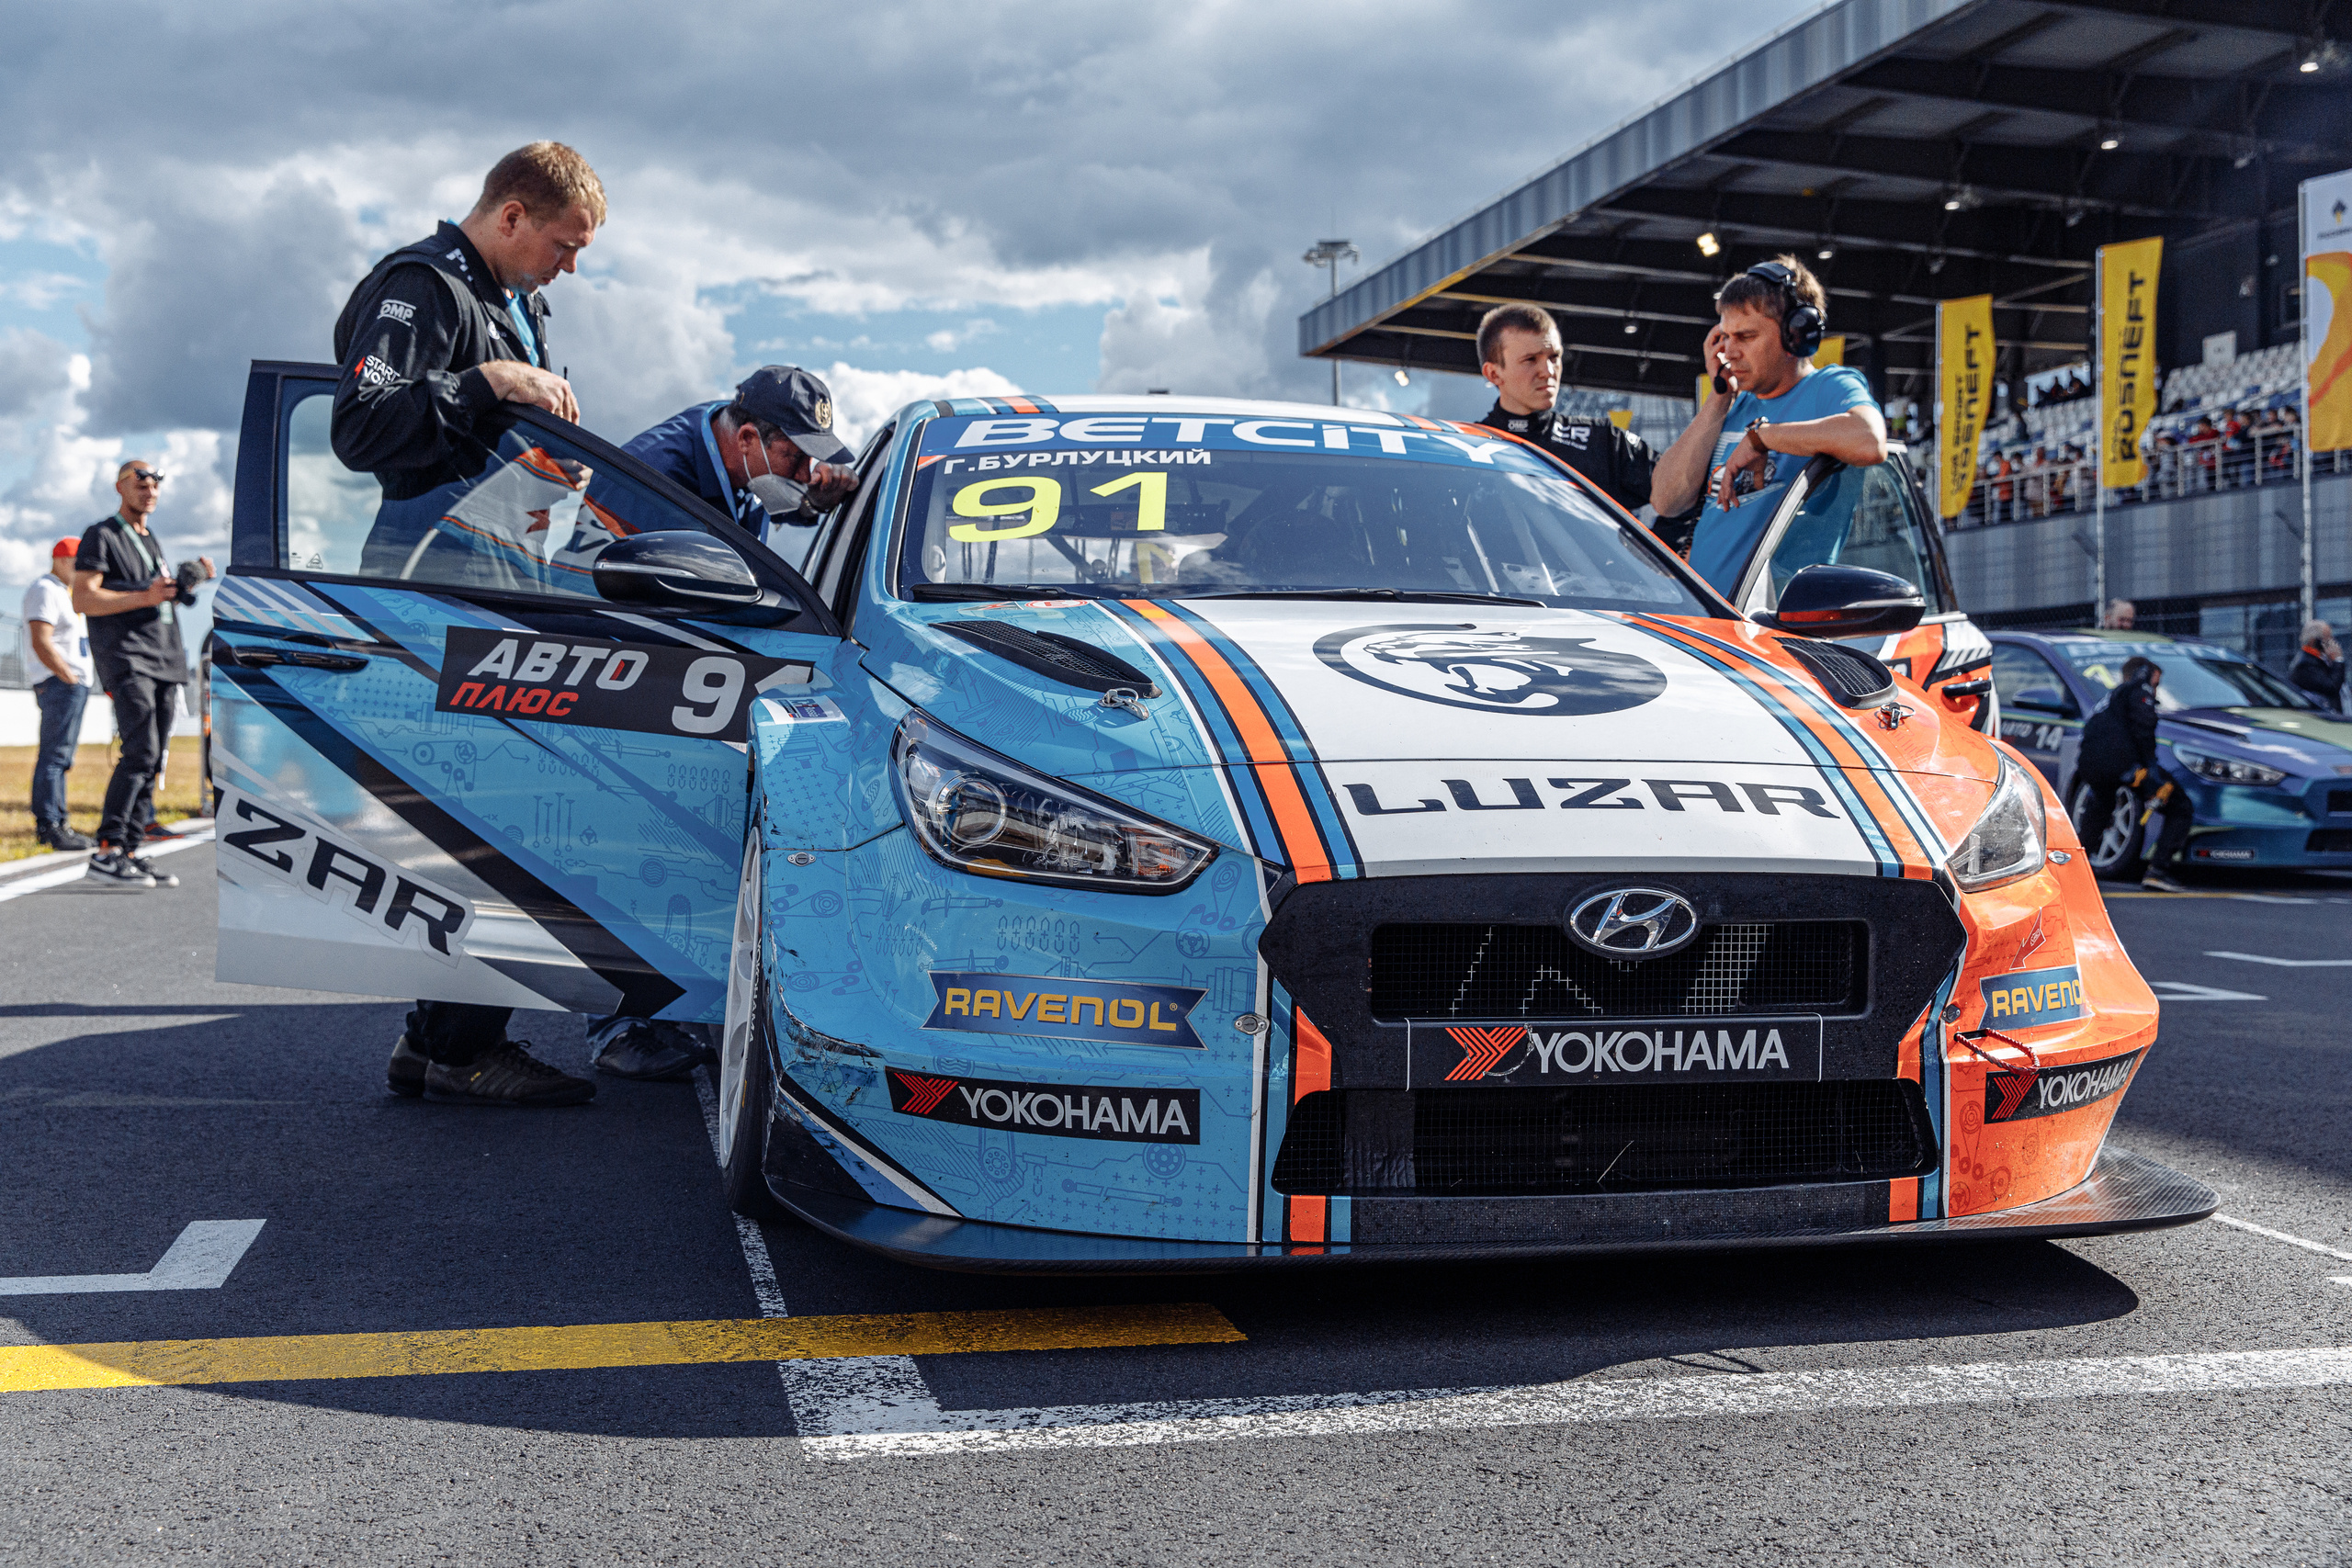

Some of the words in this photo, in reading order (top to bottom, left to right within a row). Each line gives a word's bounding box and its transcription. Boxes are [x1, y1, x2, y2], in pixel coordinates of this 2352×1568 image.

[379, 303, 413, 321] OMP
[365, 355, 401, 383] START
[2120, 270, 2145, 460] ROSNEFT
[944, 448, 1212, 475] Г.БУРЛУЦКИЙ
[954, 416, 1510, 464] BETCITY
[949, 471, 1168, 543] 91
[467, 637, 649, 692] АВТО
[449, 682, 579, 717] ПЛЮС
[2035, 724, 2064, 751] 14
[1341, 778, 1841, 819] LUZAR
[214, 785, 466, 956] ZAR
[1992, 979, 2086, 1018] RAVENO
[1533, 1029, 1790, 1074] YOKOHAMA
[2038, 1057, 2134, 1110] YOKOHAMA
[958, 1086, 1191, 1135] YOKOHAMA
